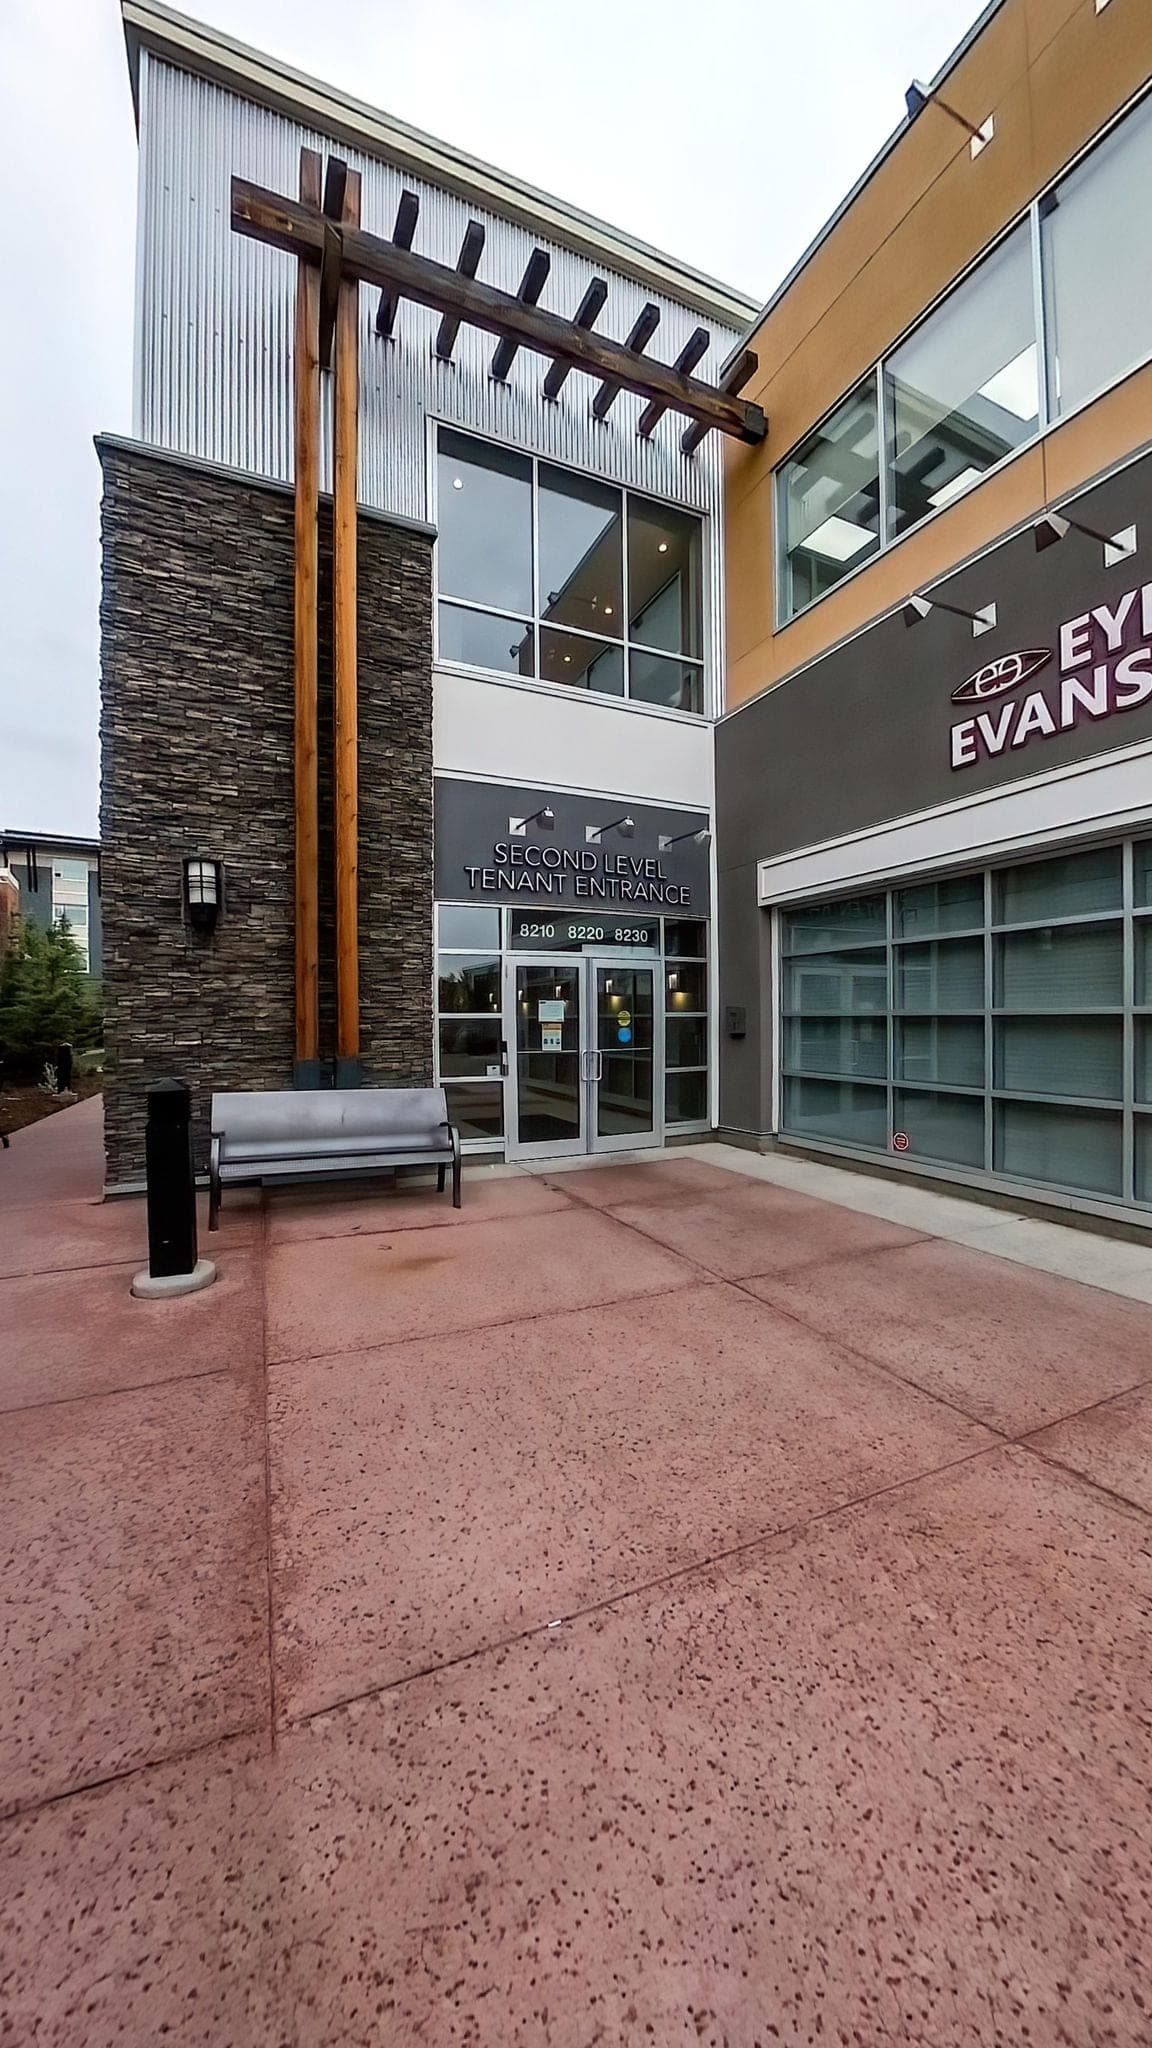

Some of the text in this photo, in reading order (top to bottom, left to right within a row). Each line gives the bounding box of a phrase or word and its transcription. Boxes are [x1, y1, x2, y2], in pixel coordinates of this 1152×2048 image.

[951, 648, 1152, 767] EVANS
[494, 842, 667, 879] SECOND LEVEL
[465, 866, 691, 904] TENANT ENTRANCE
[520, 924, 648, 942] 8210 8220 8230
